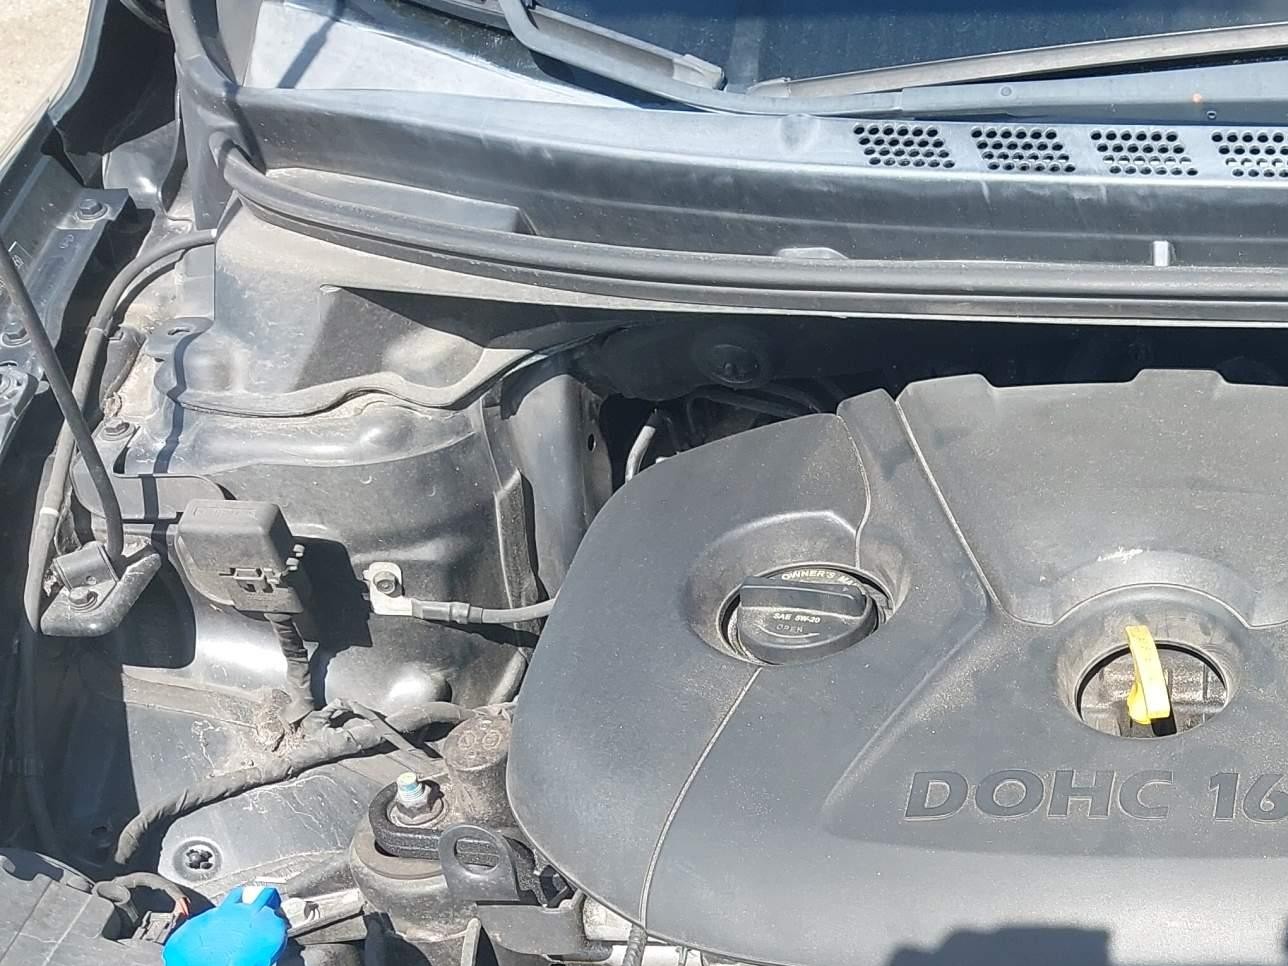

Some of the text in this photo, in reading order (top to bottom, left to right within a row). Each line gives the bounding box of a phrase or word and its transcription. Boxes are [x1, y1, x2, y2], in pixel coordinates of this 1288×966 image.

[781, 568, 836, 580] OWNER'S
[773, 612, 791, 621] SAE
[776, 623, 803, 633] OPEN
[904, 769, 1174, 822] DOHC
